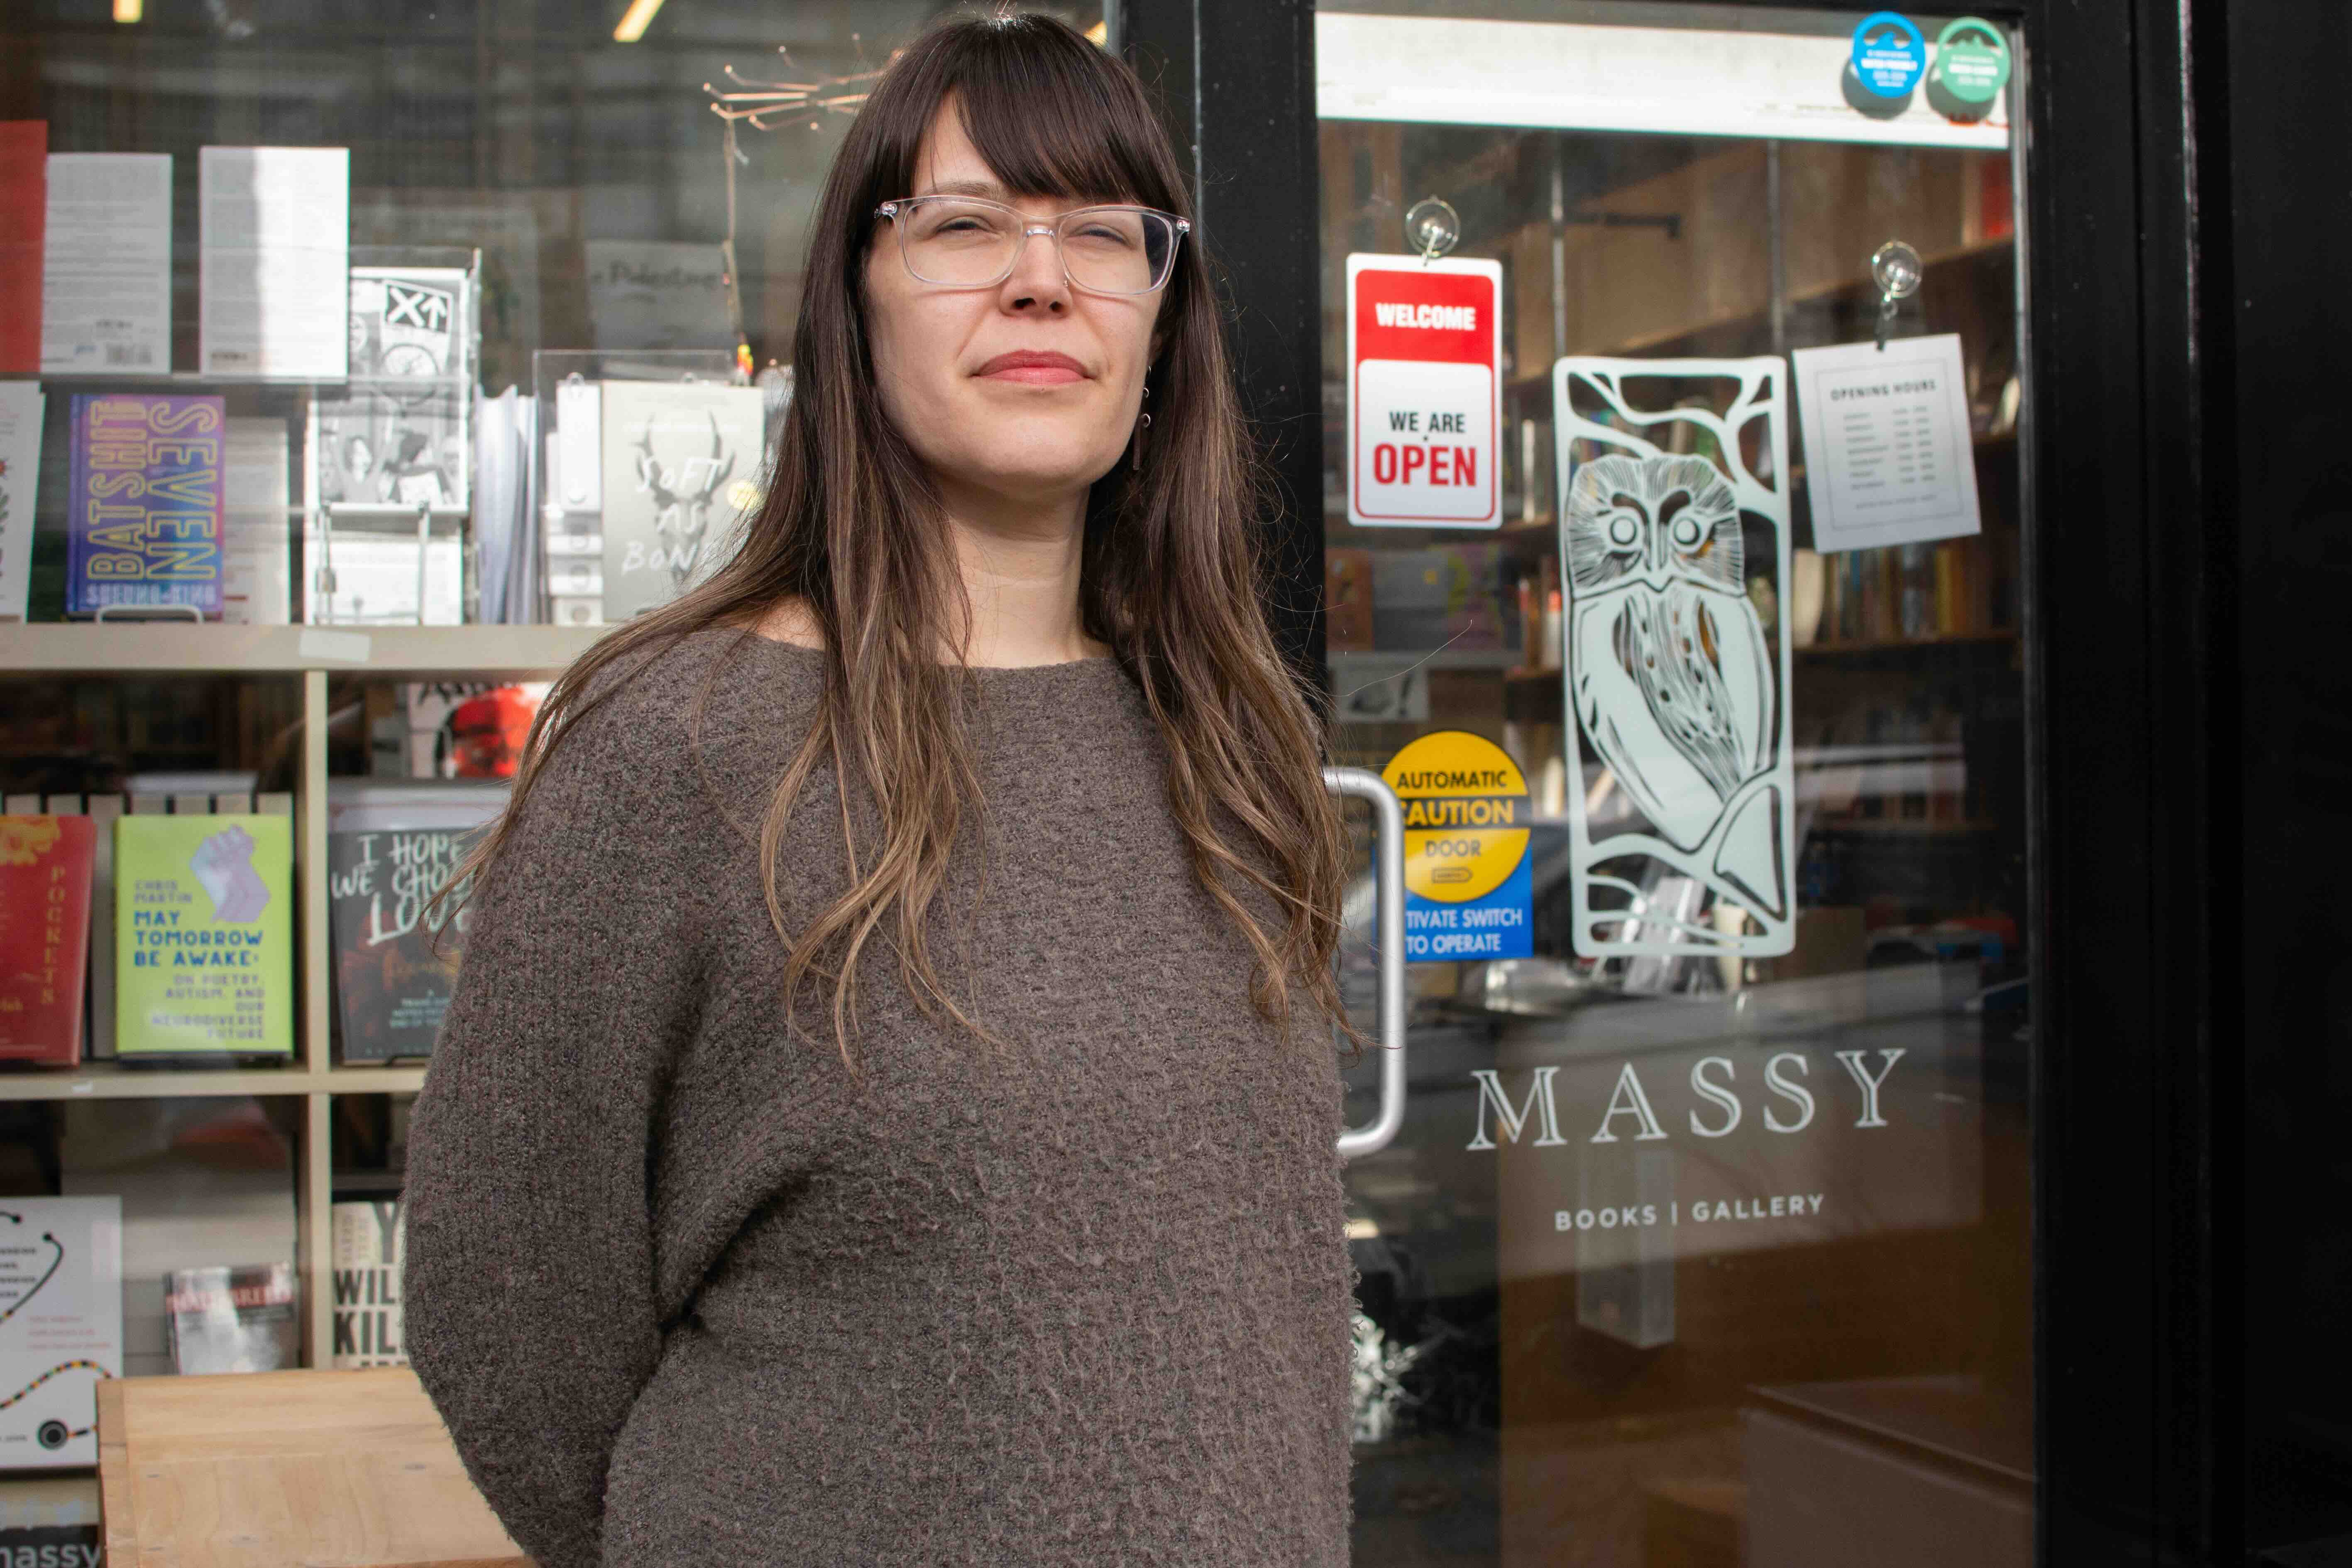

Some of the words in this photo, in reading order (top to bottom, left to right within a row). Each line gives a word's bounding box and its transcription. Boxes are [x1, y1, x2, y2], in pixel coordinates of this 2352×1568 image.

[1375, 303, 1477, 331] WELCOME
[1831, 382, 1889, 401] OPENING
[1893, 379, 1936, 394] HOURS
[1389, 411, 1419, 432] WE
[1428, 413, 1465, 433] ARE
[1373, 443, 1477, 487] OPEN
[87, 399, 147, 580] BATSHIT
[145, 401, 219, 581] SEVEN
[622, 540, 700, 576] BON
[1397, 770, 1507, 790] AUTOMATIC
[1425, 840, 1481, 857] DOOR
[332, 864, 376, 899] WE
[134, 910, 181, 926] MAY
[1406, 909, 1458, 929] TIVATE
[1462, 908, 1523, 927] SWITCH
[134, 930, 264, 946] TOMORROW
[1406, 934, 1428, 954] TO
[1432, 933, 1501, 954] OPERATE
[134, 949, 160, 967] BE
[1466, 1048, 1907, 1151] MASSY
[1554, 1205, 1658, 1231] BOOKS
[1692, 1194, 1824, 1223] GALLERY
[333, 1269, 396, 1305] WIL
[333, 1311, 399, 1355] KIL
[0, 1544, 100, 1568] assy
